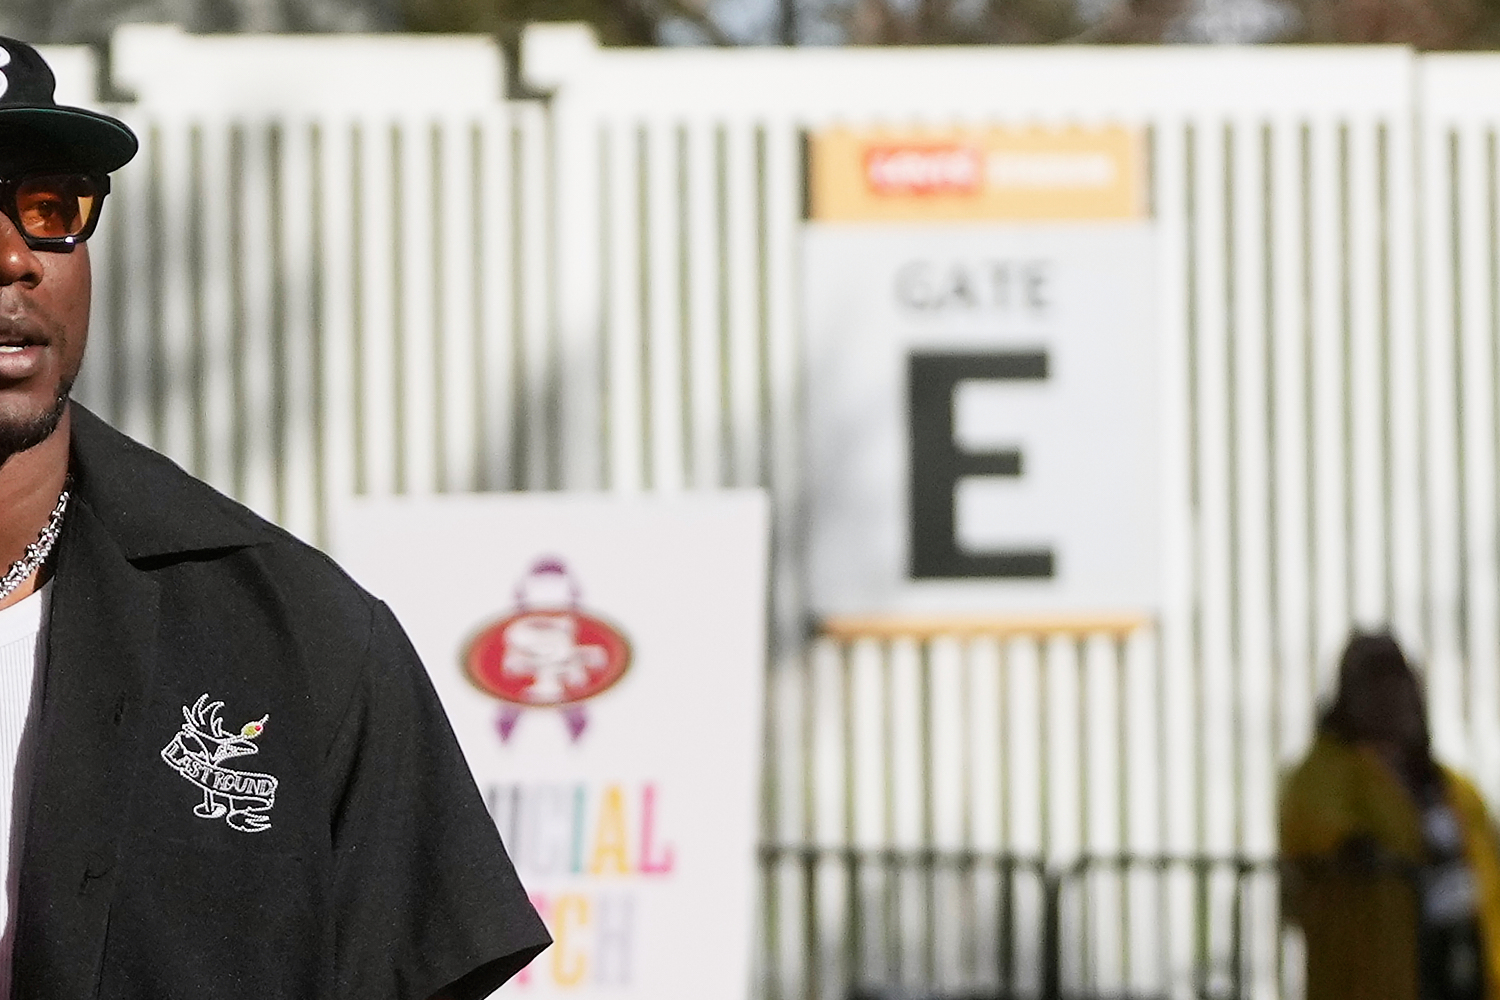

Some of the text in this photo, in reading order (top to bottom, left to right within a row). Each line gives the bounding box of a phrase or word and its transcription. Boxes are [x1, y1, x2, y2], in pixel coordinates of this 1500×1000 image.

[896, 259, 1052, 309] GATE
[908, 350, 1054, 578] E
[167, 741, 273, 796] LAST ROUND
